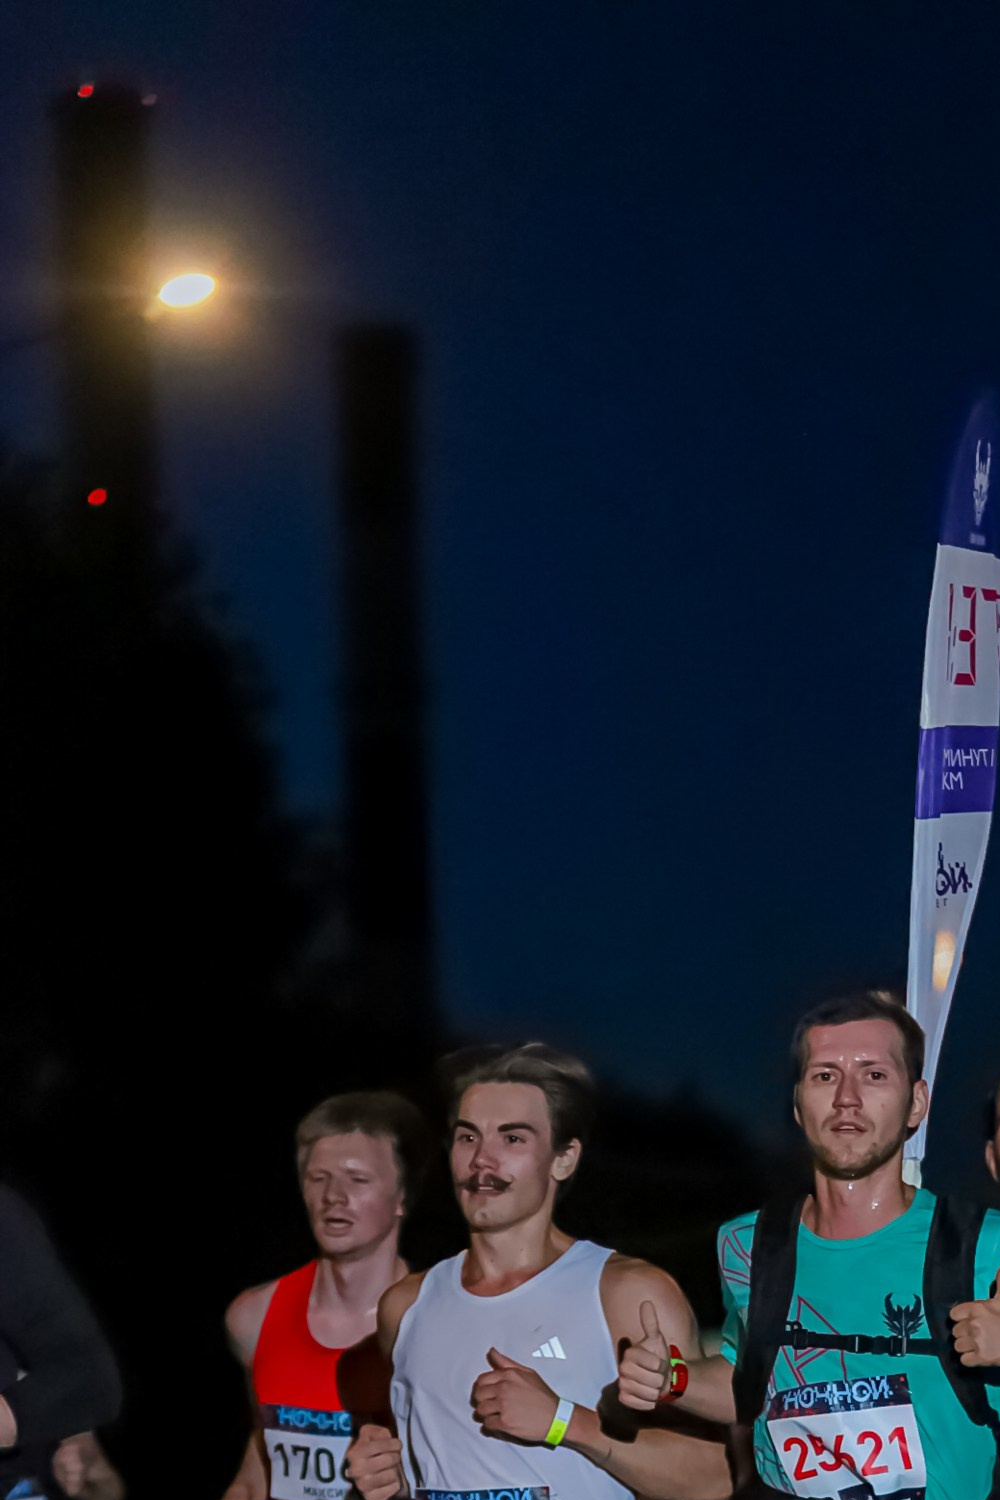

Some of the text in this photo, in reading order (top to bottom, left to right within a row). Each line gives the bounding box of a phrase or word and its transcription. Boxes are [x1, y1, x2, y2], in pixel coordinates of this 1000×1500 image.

[942, 771, 964, 790] КМ
[277, 1407, 352, 1432] НОЧНО
[303, 1486, 344, 1500] МАКСИ
